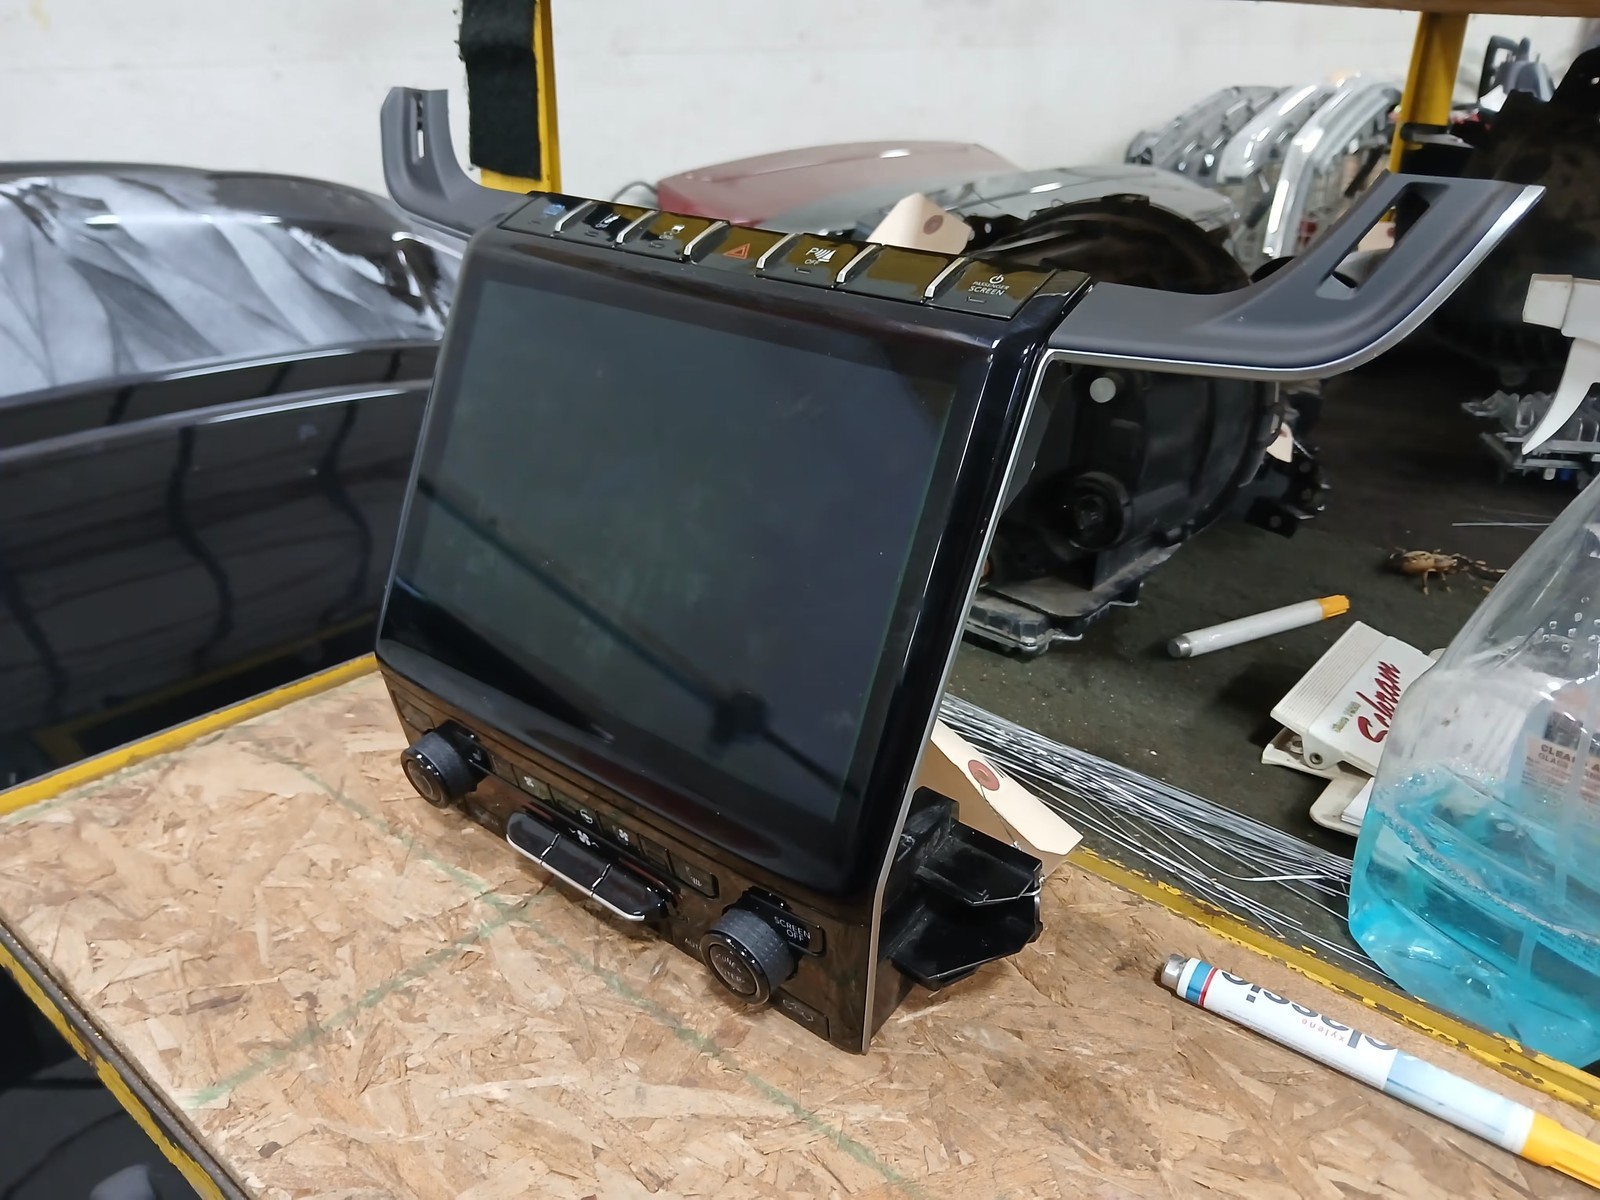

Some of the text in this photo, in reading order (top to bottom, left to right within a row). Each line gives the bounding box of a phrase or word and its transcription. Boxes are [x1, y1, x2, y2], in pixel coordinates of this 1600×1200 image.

[968, 285, 1005, 296] SCREEN
[972, 280, 1010, 290] PASSENGER
[774, 916, 811, 940] SCREEN
[786, 929, 804, 941] OFF
[1302, 1018, 1345, 1042] xylene
